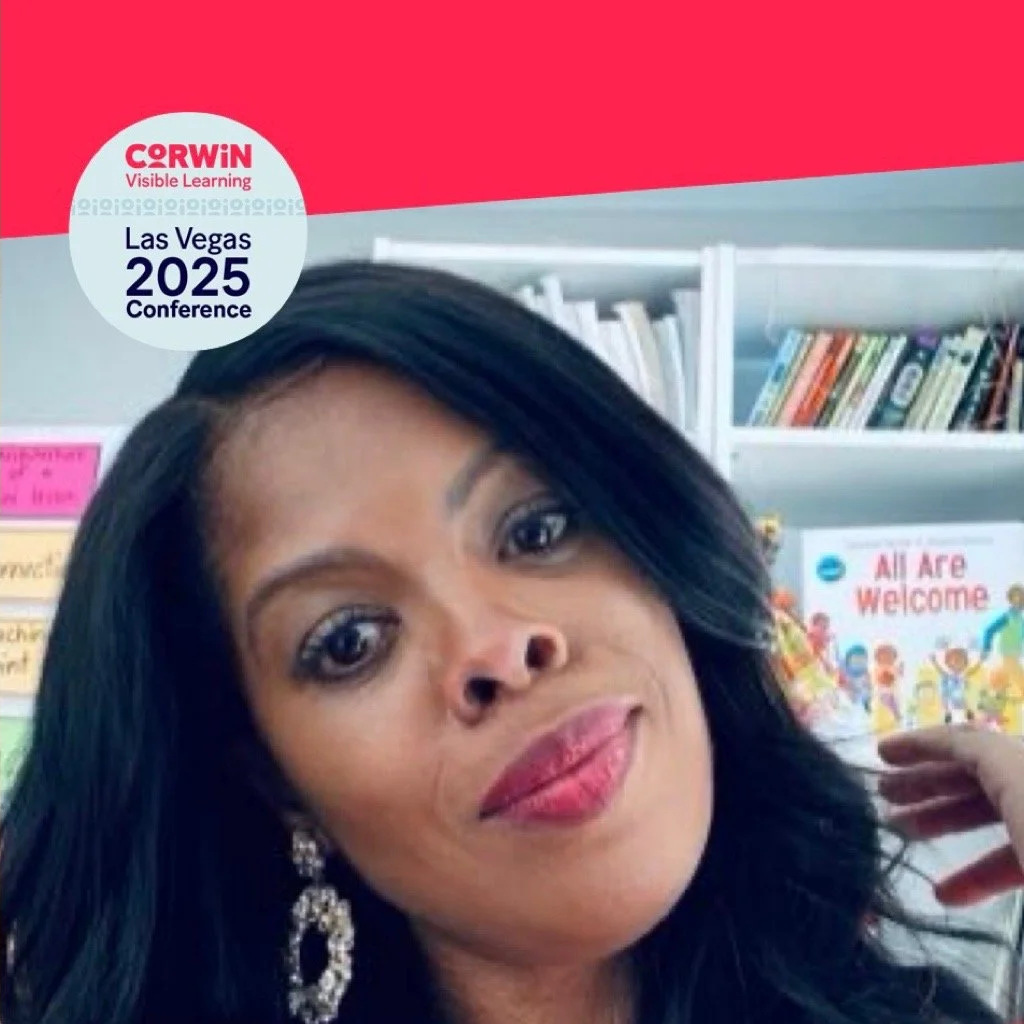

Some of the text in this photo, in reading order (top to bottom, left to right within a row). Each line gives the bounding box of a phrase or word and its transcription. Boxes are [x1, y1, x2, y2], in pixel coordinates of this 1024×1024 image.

[126, 173, 251, 191] Visible Learning
[126, 227, 252, 255] Las Vegas
[126, 256, 250, 297] 2025
[126, 299, 252, 318] Conference
[874, 550, 907, 581] All
[918, 551, 967, 580] Are
[856, 583, 989, 616] Welcome
